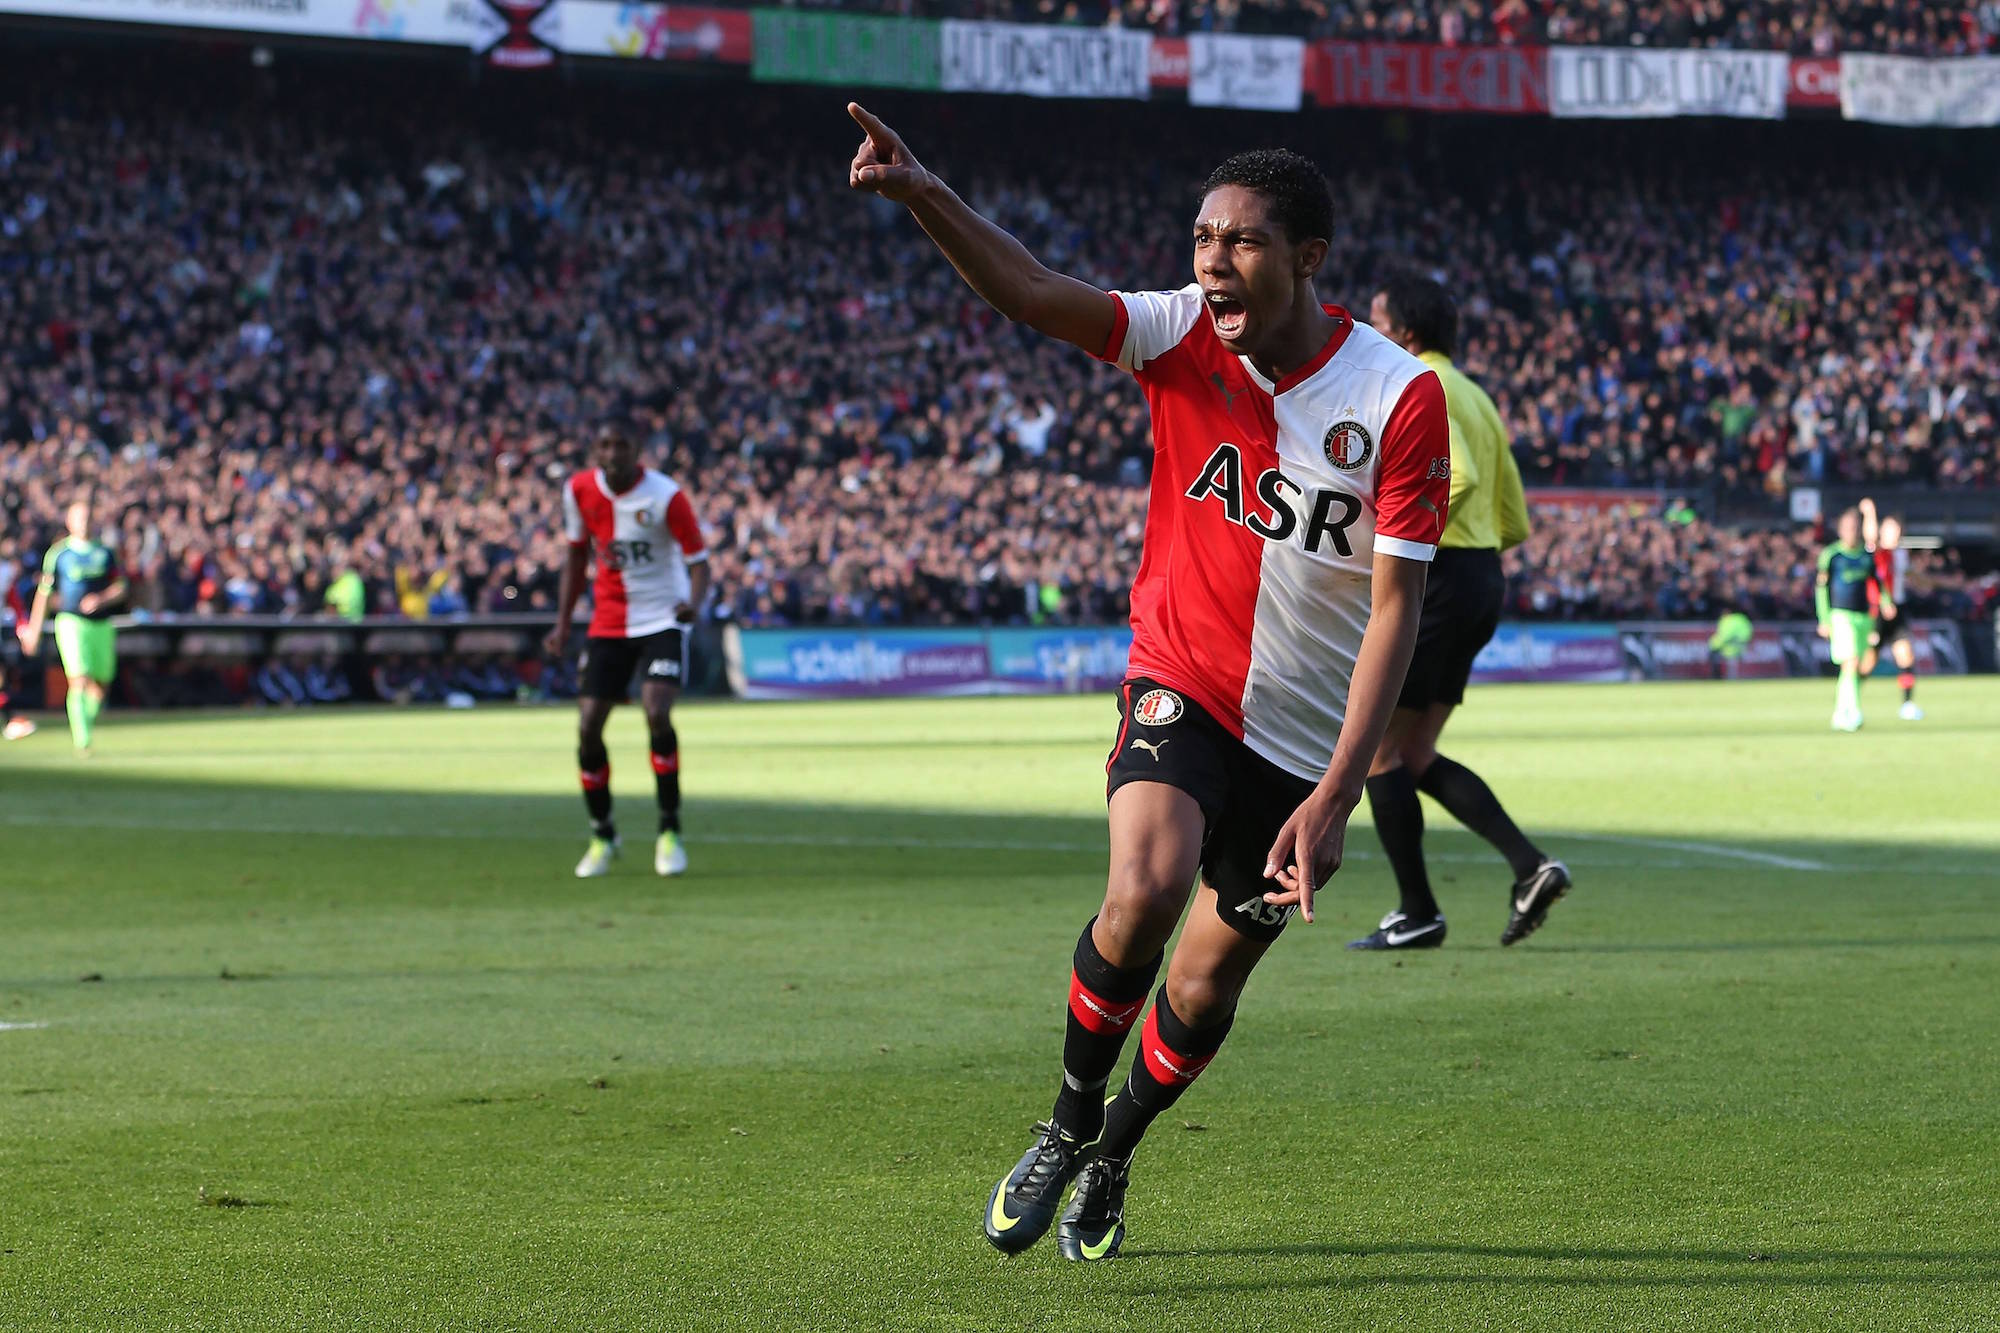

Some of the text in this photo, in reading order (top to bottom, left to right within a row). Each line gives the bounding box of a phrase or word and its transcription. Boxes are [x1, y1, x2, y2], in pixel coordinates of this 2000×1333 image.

[1425, 457, 1451, 480] AS
[1185, 443, 1362, 557] ASR
[606, 540, 654, 568] SR
